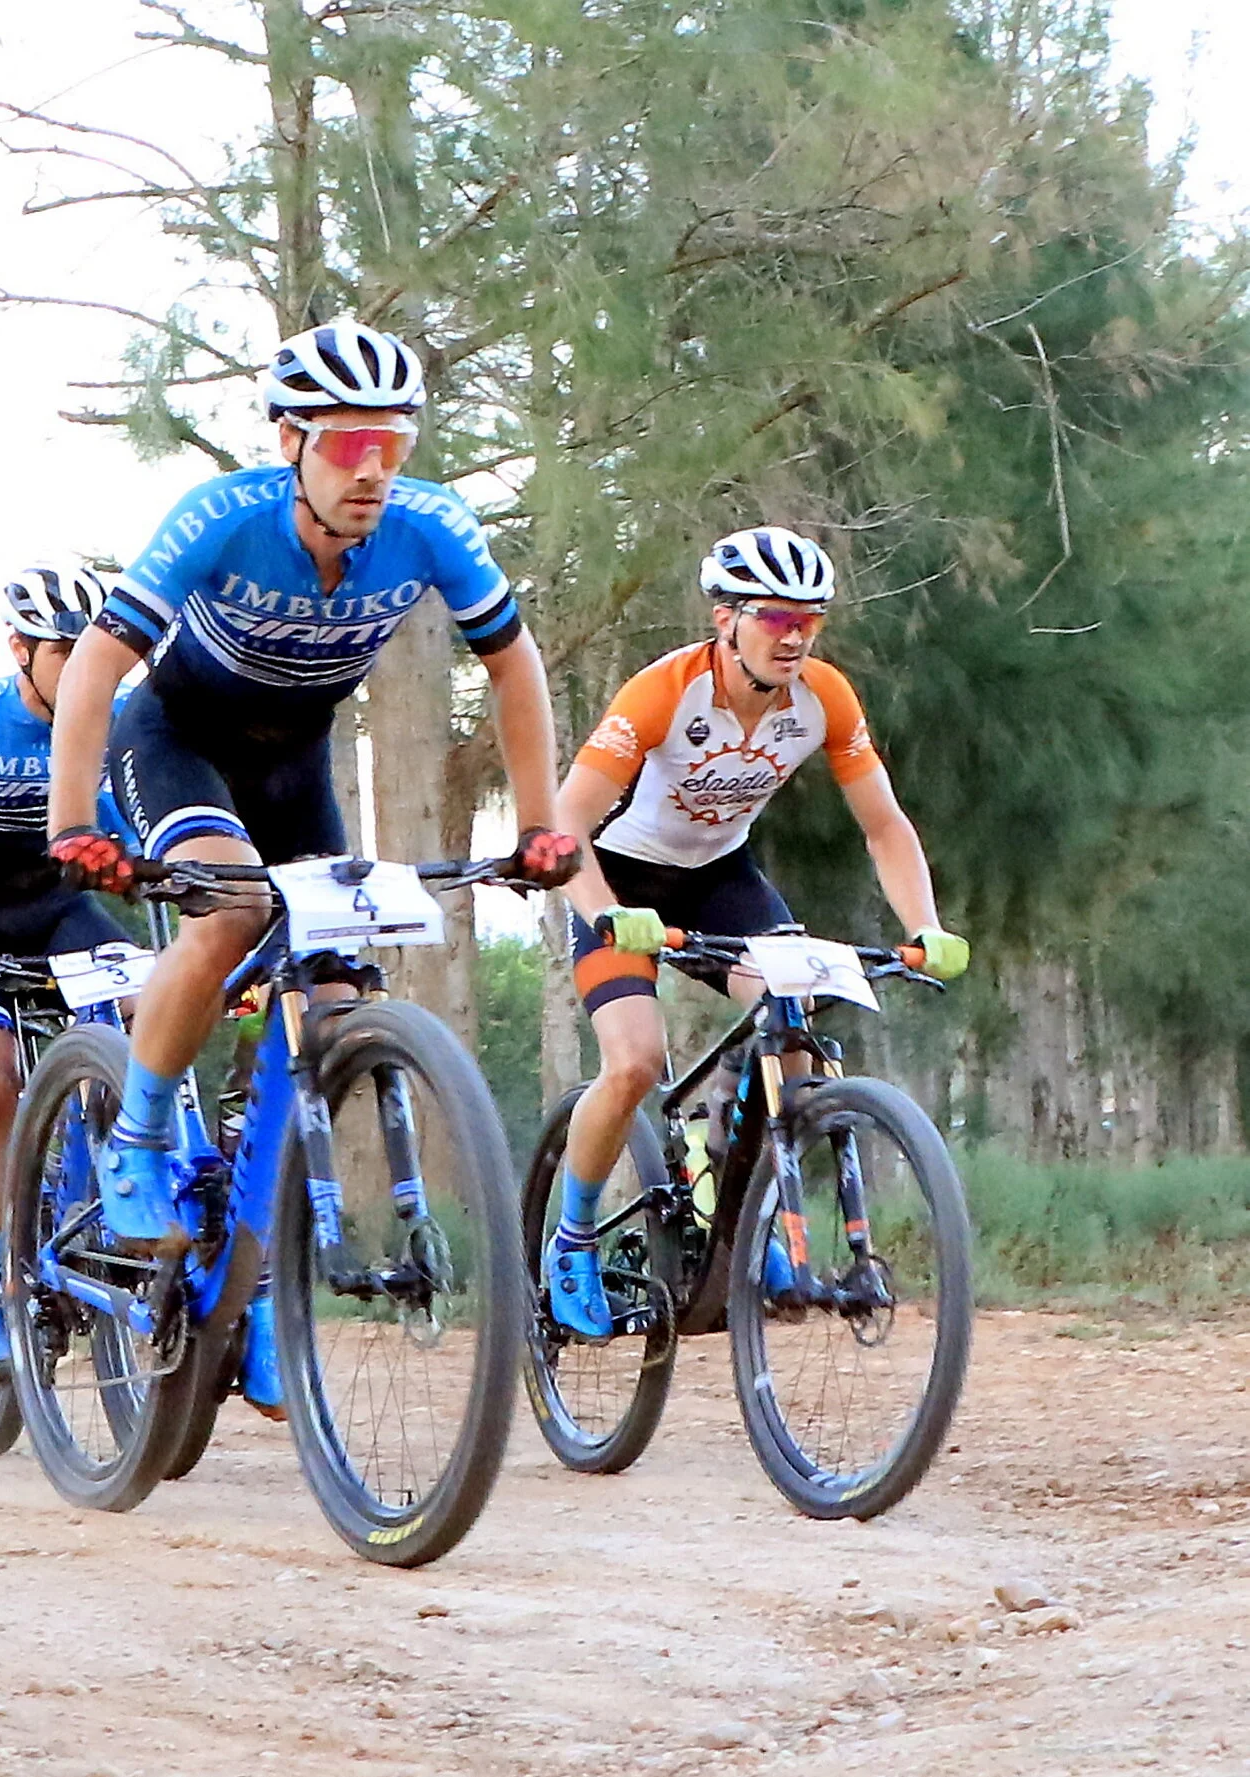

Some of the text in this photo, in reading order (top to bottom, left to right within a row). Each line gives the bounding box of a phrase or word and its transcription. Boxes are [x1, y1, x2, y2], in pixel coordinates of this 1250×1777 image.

[139, 480, 286, 585] IMBUKO
[219, 569, 422, 619] IMBUKO
[353, 888, 378, 922] 4
[107, 966, 130, 985] 3
